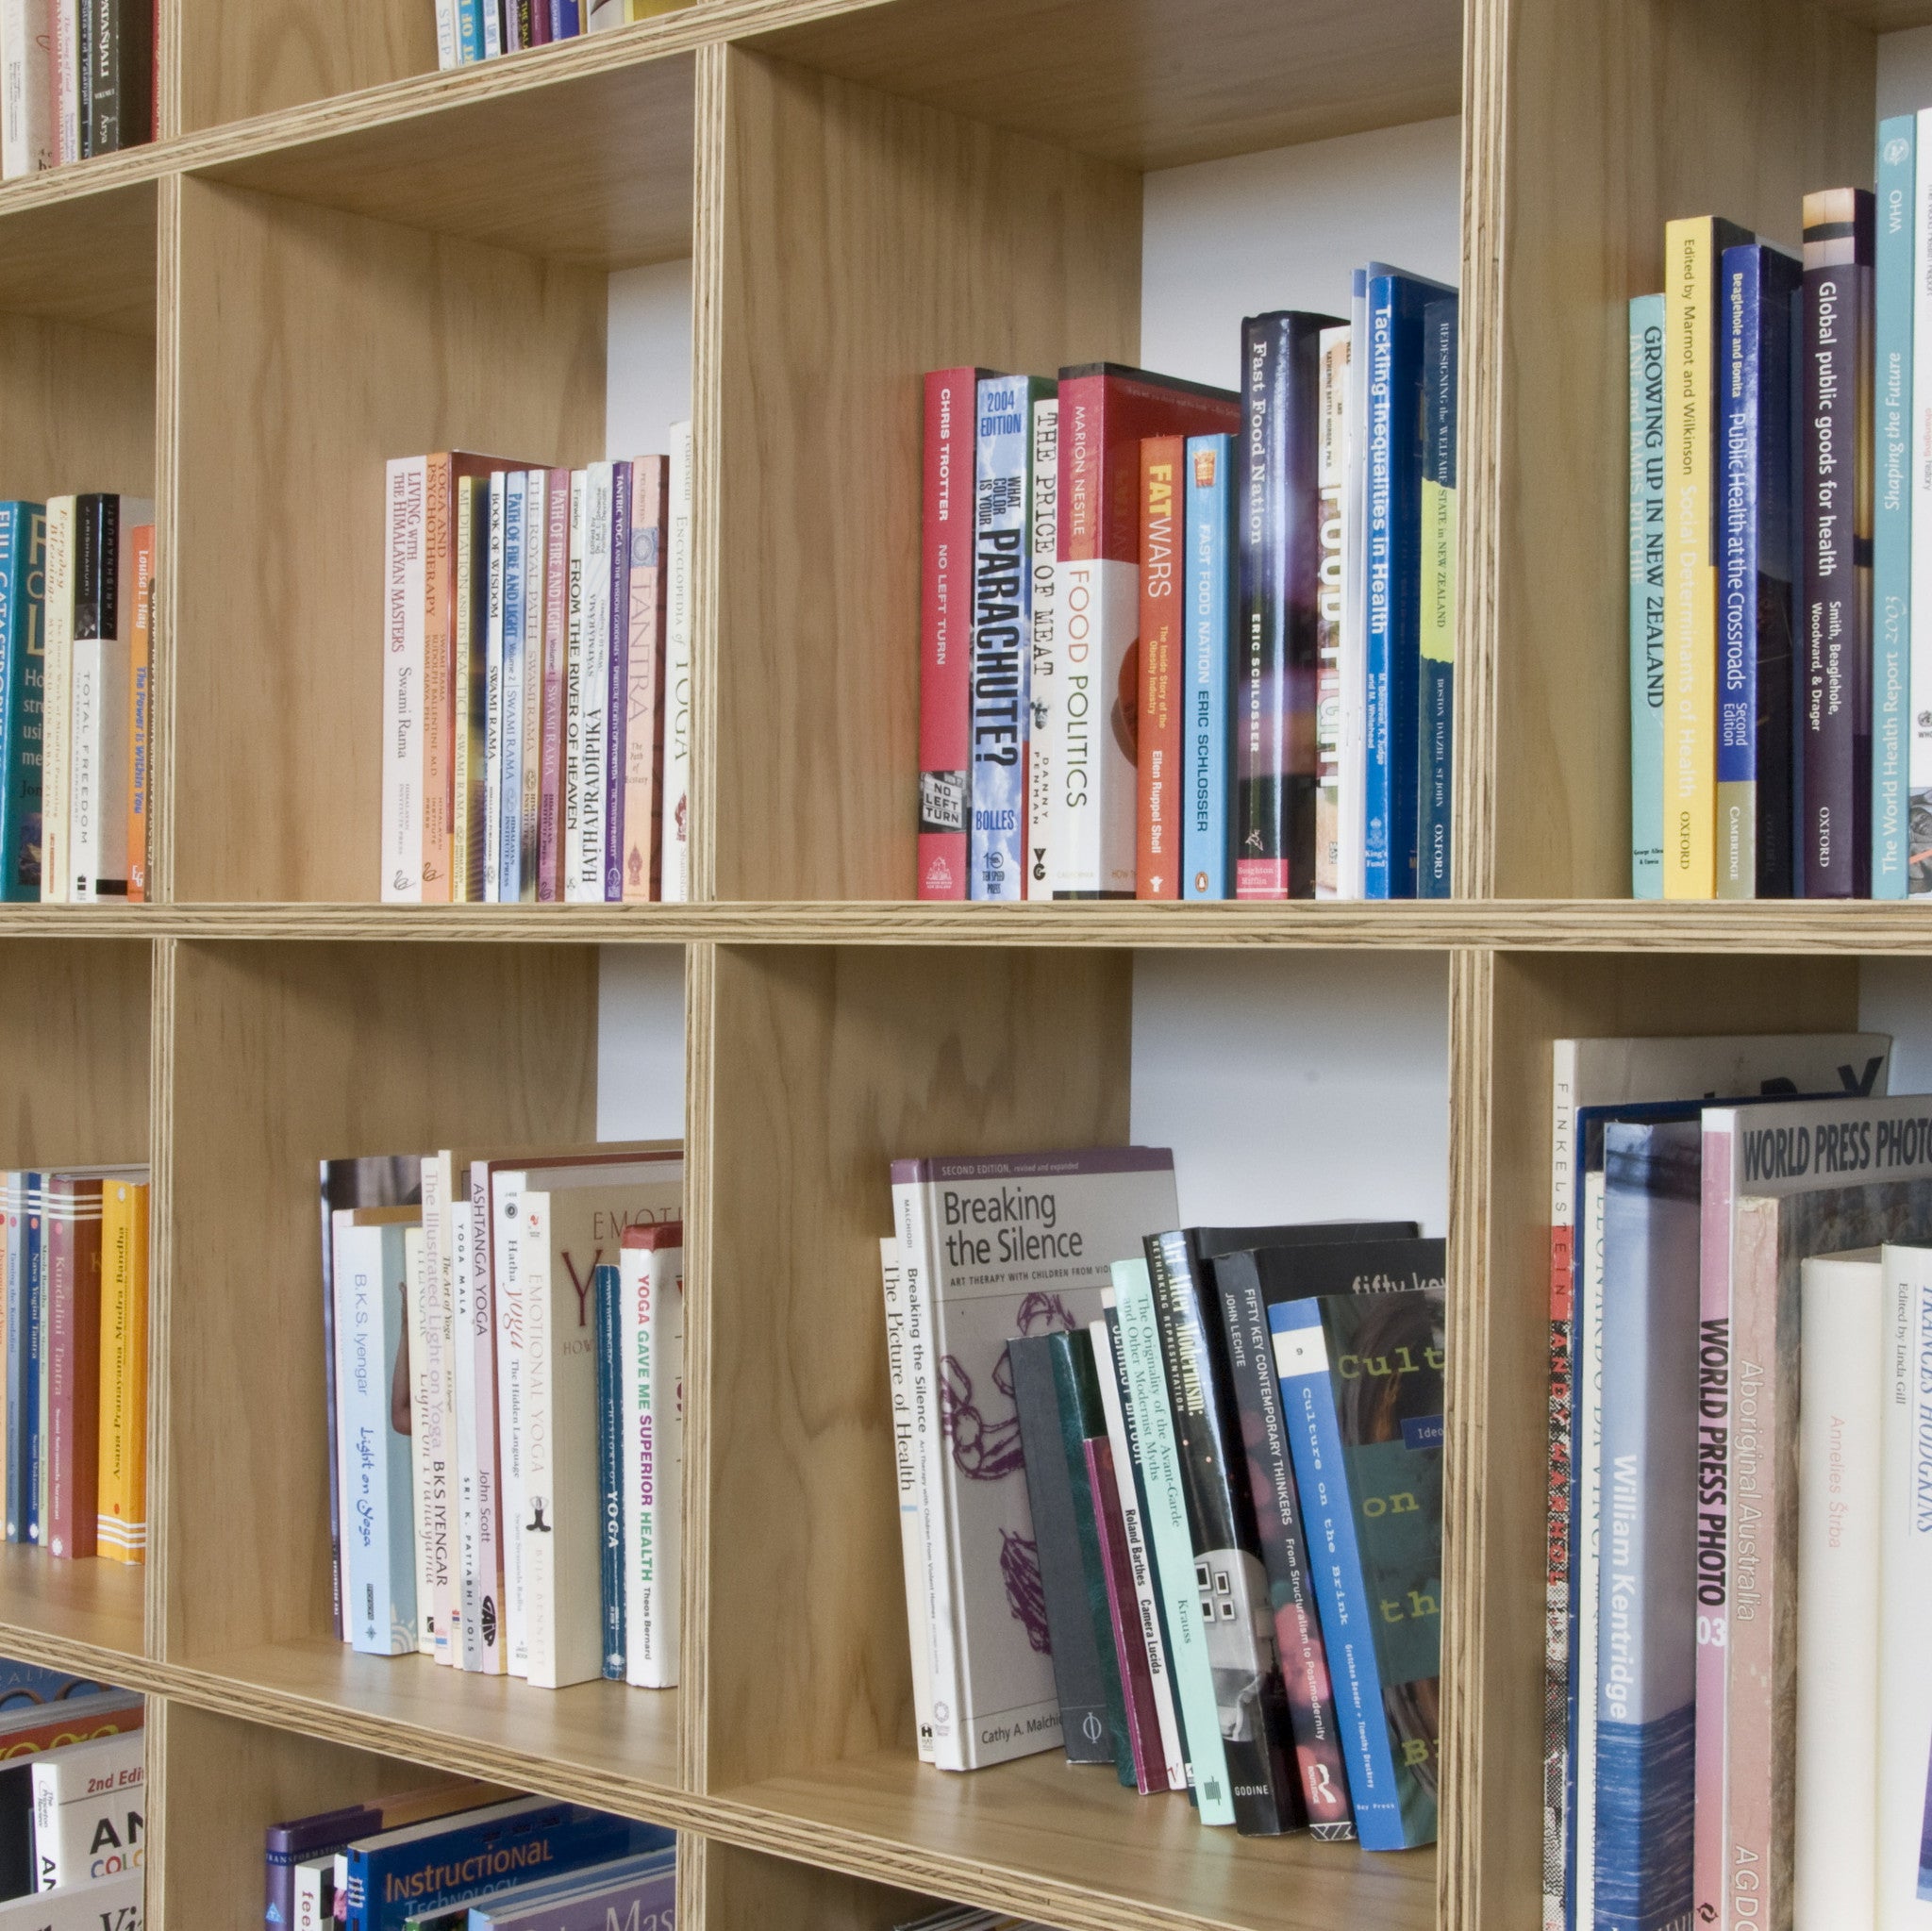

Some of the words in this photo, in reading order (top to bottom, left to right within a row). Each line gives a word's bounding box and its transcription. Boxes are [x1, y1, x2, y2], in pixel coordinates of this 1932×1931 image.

[1889, 189, 1904, 235] WHO
[1682, 239, 1695, 280] Edited
[1680, 284, 1695, 299] by
[1819, 281, 1839, 343] Global
[1371, 305, 1391, 394] Tackling
[1682, 307, 1696, 366] Marmot
[1251, 341, 1267, 391] Fast
[1643, 325, 1663, 449] GROWING
[1682, 370, 1696, 406] and
[1816, 350, 1839, 409] public
[940, 388, 951, 440] CHRIS
[981, 413, 1022, 438] EDITION
[987, 392, 1015, 413] 2004
[1037, 412, 1058, 462] THE
[1074, 406, 1087, 473] MARION
[1250, 399, 1267, 456] Food
[1682, 409, 1696, 476] Wilkinson
[1727, 412, 1748, 470] Public
[1815, 415, 1837, 474] goods
[392, 473, 406, 499] THE
[938, 443, 950, 521] TROTTER
[979, 479, 992, 490] IS
[1369, 402, 1390, 532] Inequalities
[1645, 457, 1664, 491] UP
[406, 472, 421, 525] LIVING
[491, 493, 501, 532] BOOK
[978, 494, 993, 525] YOUR
[992, 478, 1008, 515] COLOR
[1007, 476, 1022, 508] WHAT
[1036, 474, 1057, 554] PRICE
[1073, 479, 1086, 535] NESTLE
[1251, 463, 1266, 545] Nation
[1645, 499, 1664, 523] IN
[1727, 473, 1747, 534] Health
[1819, 479, 1837, 508] for
[391, 501, 407, 585] HIMALAYAN
[406, 527, 419, 561] WITH
[491, 536, 500, 554] OF
[938, 544, 948, 569] NO
[1198, 524, 1212, 565] FAST
[1373, 537, 1389, 557] in
[1646, 532, 1665, 589] NEW
[1727, 538, 1745, 555] at
[1818, 515, 1837, 577] health
[138, 550, 151, 588] Louise
[490, 558, 500, 619] WISDOM
[570, 558, 582, 614] FROM
[1034, 565, 1056, 598] OF
[1727, 559, 1746, 589] the
[139, 591, 149, 601] L.
[937, 574, 947, 613] LEFT
[1068, 569, 1091, 663] FOOD
[1198, 571, 1211, 615] FOOD
[1369, 564, 1388, 635] Health
[136, 604, 149, 630] Hay
[391, 589, 405, 654] MASTERS
[569, 619, 581, 656] THE
[1250, 614, 1262, 652] ERIC
[1810, 602, 1824, 673] Woodward,
[1828, 601, 1842, 641] Smith,
[936, 618, 947, 665] TURN
[975, 527, 1022, 767] PARACHUTE?
[1033, 611, 1054, 676] MEAT
[1197, 622, 1211, 684] NATION
[1646, 595, 1665, 709] ZEALAND
[1725, 592, 1746, 691] Crossroads
[397, 666, 413, 714] Swami
[568, 662, 581, 718] RIVER
[1811, 675, 1824, 686] &
[1827, 643, 1842, 715] Beaglehole,
[82, 671, 92, 735] TOTAL
[1197, 690, 1210, 728] ERIC
[1249, 657, 1261, 753] SCHLOSSER
[1723, 703, 1737, 747] Edition
[1735, 702, 1749, 747] Second
[1808, 690, 1823, 731] Drager
[397, 718, 412, 758] Rama
[568, 723, 580, 751] OF
[1066, 674, 1090, 808] POLITICS
[1152, 750, 1164, 778] Ellen
[1196, 733, 1209, 832] SCHLOSSER
[80, 744, 91, 844] FREEDOM
[567, 757, 579, 831] HEAVEN
[925, 793, 958, 811] LEFT
[933, 784, 952, 800] NO
[1149, 782, 1164, 821] Ruppel
[925, 807, 960, 824] TURN
[975, 809, 1016, 831] BOLLES
[1820, 808, 1830, 868] OXFORD
[1151, 824, 1163, 854] Shell
[1433, 824, 1444, 879] OXFORD
[1679, 810, 1691, 871] OXFORD
[1743, 1126, 1811, 1182] WORLD
[1814, 1121, 1872, 1174] PRESS
[944, 1187, 1057, 1228] Breaking
[1555, 1082, 1569, 1296] FINKELSTEIN
[473, 1183, 486, 1276] ASHTANGA
[945, 1230, 991, 1267] the
[997, 1227, 1084, 1263] Silence
[355, 1273, 368, 1327] B.K.S.
[638, 1273, 651, 1324] YOGA
[885, 1264, 902, 1303] The
[1243, 1289, 1260, 1323] FIFTY
[1897, 1282, 1909, 1323] Edited
[475, 1284, 489, 1337] YOGA
[1224, 1292, 1241, 1323] JOHN
[637, 1330, 651, 1377] GAVE
[889, 1313, 907, 1385] Picture
[1229, 1325, 1247, 1368] LECHTE
[1250, 1326, 1265, 1351] KEY
[1894, 1325, 1907, 1340] by
[356, 1333, 370, 1395] Iyengar
[1699, 1316, 1730, 1419] WORLD
[1896, 1343, 1908, 1377] Linda
[638, 1382, 651, 1409] ME
[893, 1394, 909, 1412] of
[1254, 1354, 1282, 1457] CONTEMPORARY
[1895, 1381, 1907, 1406] Gill
[357, 1427, 375, 1470] Light
[1732, 1359, 1765, 1498] Aboriginal
[639, 1414, 653, 1507] SUPERIOR
[896, 1422, 917, 1492] Health
[1698, 1424, 1728, 1507] PRESS
[1827, 1415, 1846, 1494] Annelies
[360, 1473, 371, 1494] on
[479, 1469, 491, 1501] John
[1272, 1459, 1294, 1526] THINKERS
[357, 1499, 375, 1548] Yoga
[479, 1507, 492, 1543] Scott
[1124, 1508, 1140, 1544] Roland
[1610, 1454, 1639, 1567] William
[434, 1505, 449, 1588] IYENGAR
[641, 1511, 654, 1581] HEALTH
[1131, 1546, 1147, 1587] Barthes
[1697, 1511, 1727, 1608] PHOTO
[1735, 1504, 1763, 1622] Australia
[643, 1587, 652, 1617] Theos
[1140, 1599, 1155, 1638] Camera
[643, 1620, 653, 1660] Bernard
[1605, 1573, 1637, 1720] Kentridge
[1697, 1614, 1728, 1648] 03
[1144, 1640, 1162, 1675] Lucida
[87, 1772, 115, 1793] 2nd
[1234, 1785, 1270, 1797] GODINE
